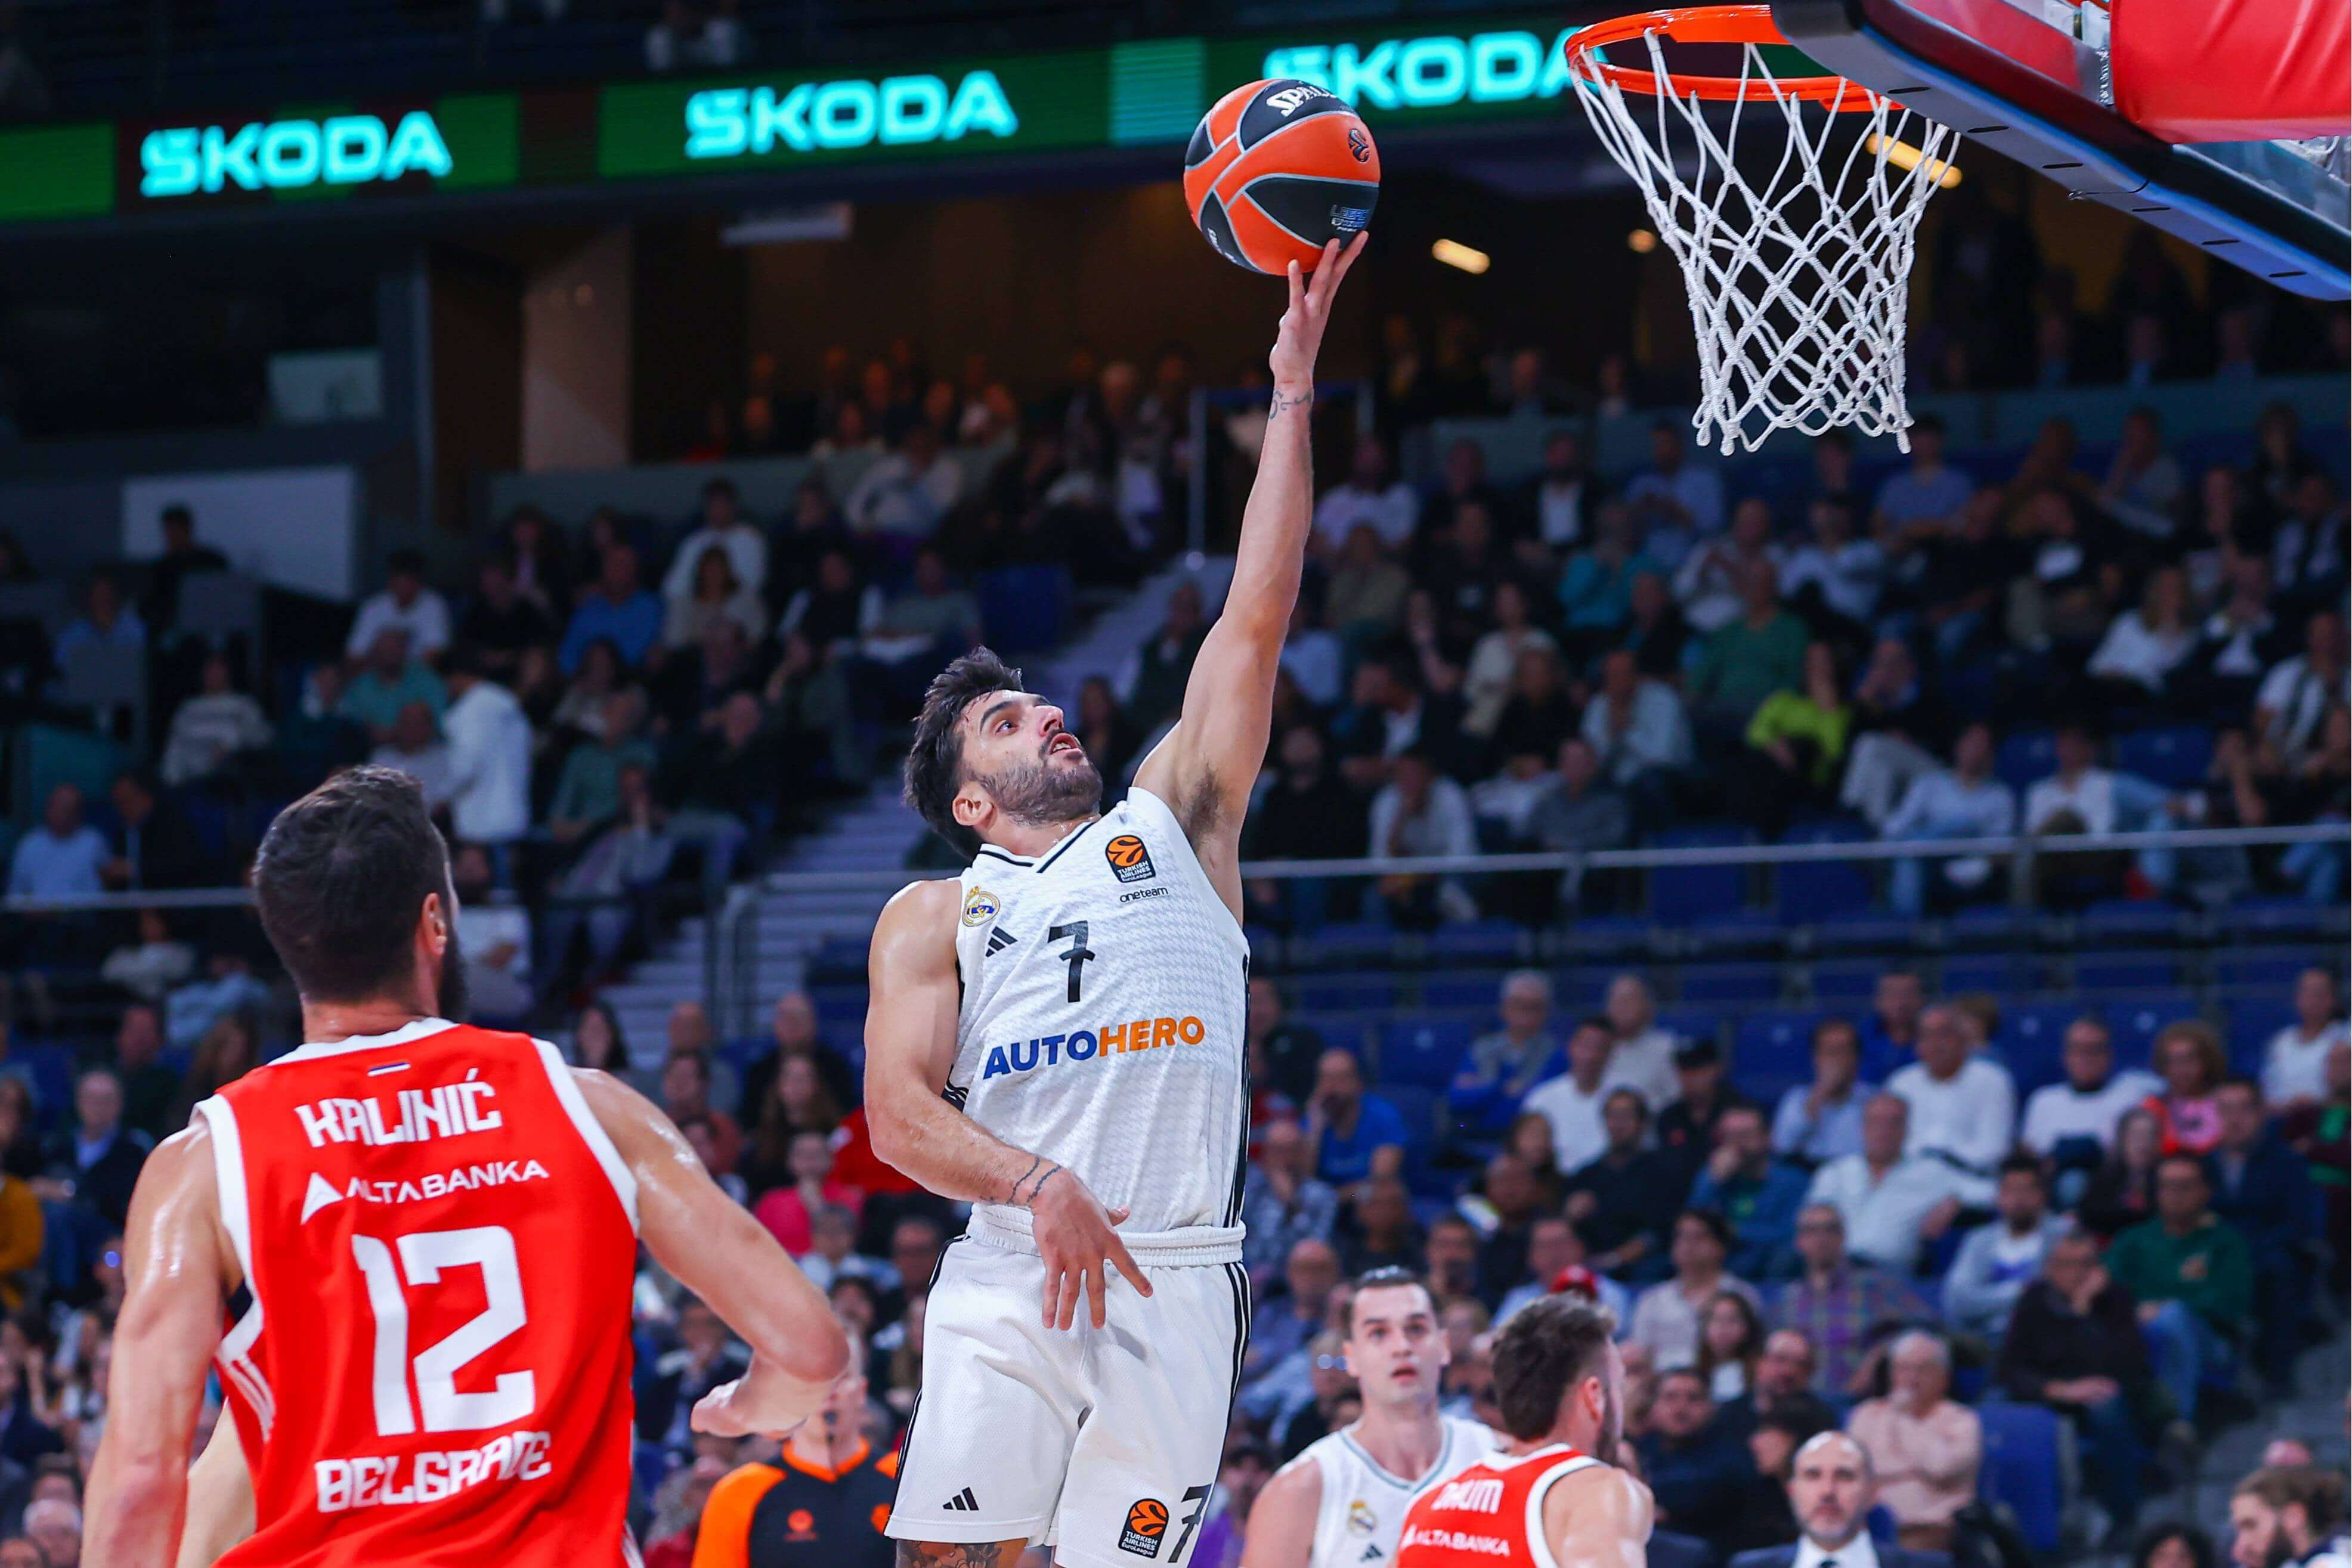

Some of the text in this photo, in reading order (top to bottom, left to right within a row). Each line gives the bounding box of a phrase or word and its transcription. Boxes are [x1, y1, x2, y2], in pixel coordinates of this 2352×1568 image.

[1118, 860, 1149, 875] TURKISH
[1120, 887, 1169, 903] oneteam
[1048, 919, 1096, 1003] 7
[983, 1015, 1205, 1080] AUTOHERO
[294, 1068, 503, 1148] KALINIĆ
[351, 1225, 536, 1437] 12
[314, 1430, 552, 1513] BELGRADE
[1124, 1537, 1156, 1551] AIRLINES
[1126, 1530, 1158, 1545] TURKISH
[1167, 1483, 1213, 1563] 7
